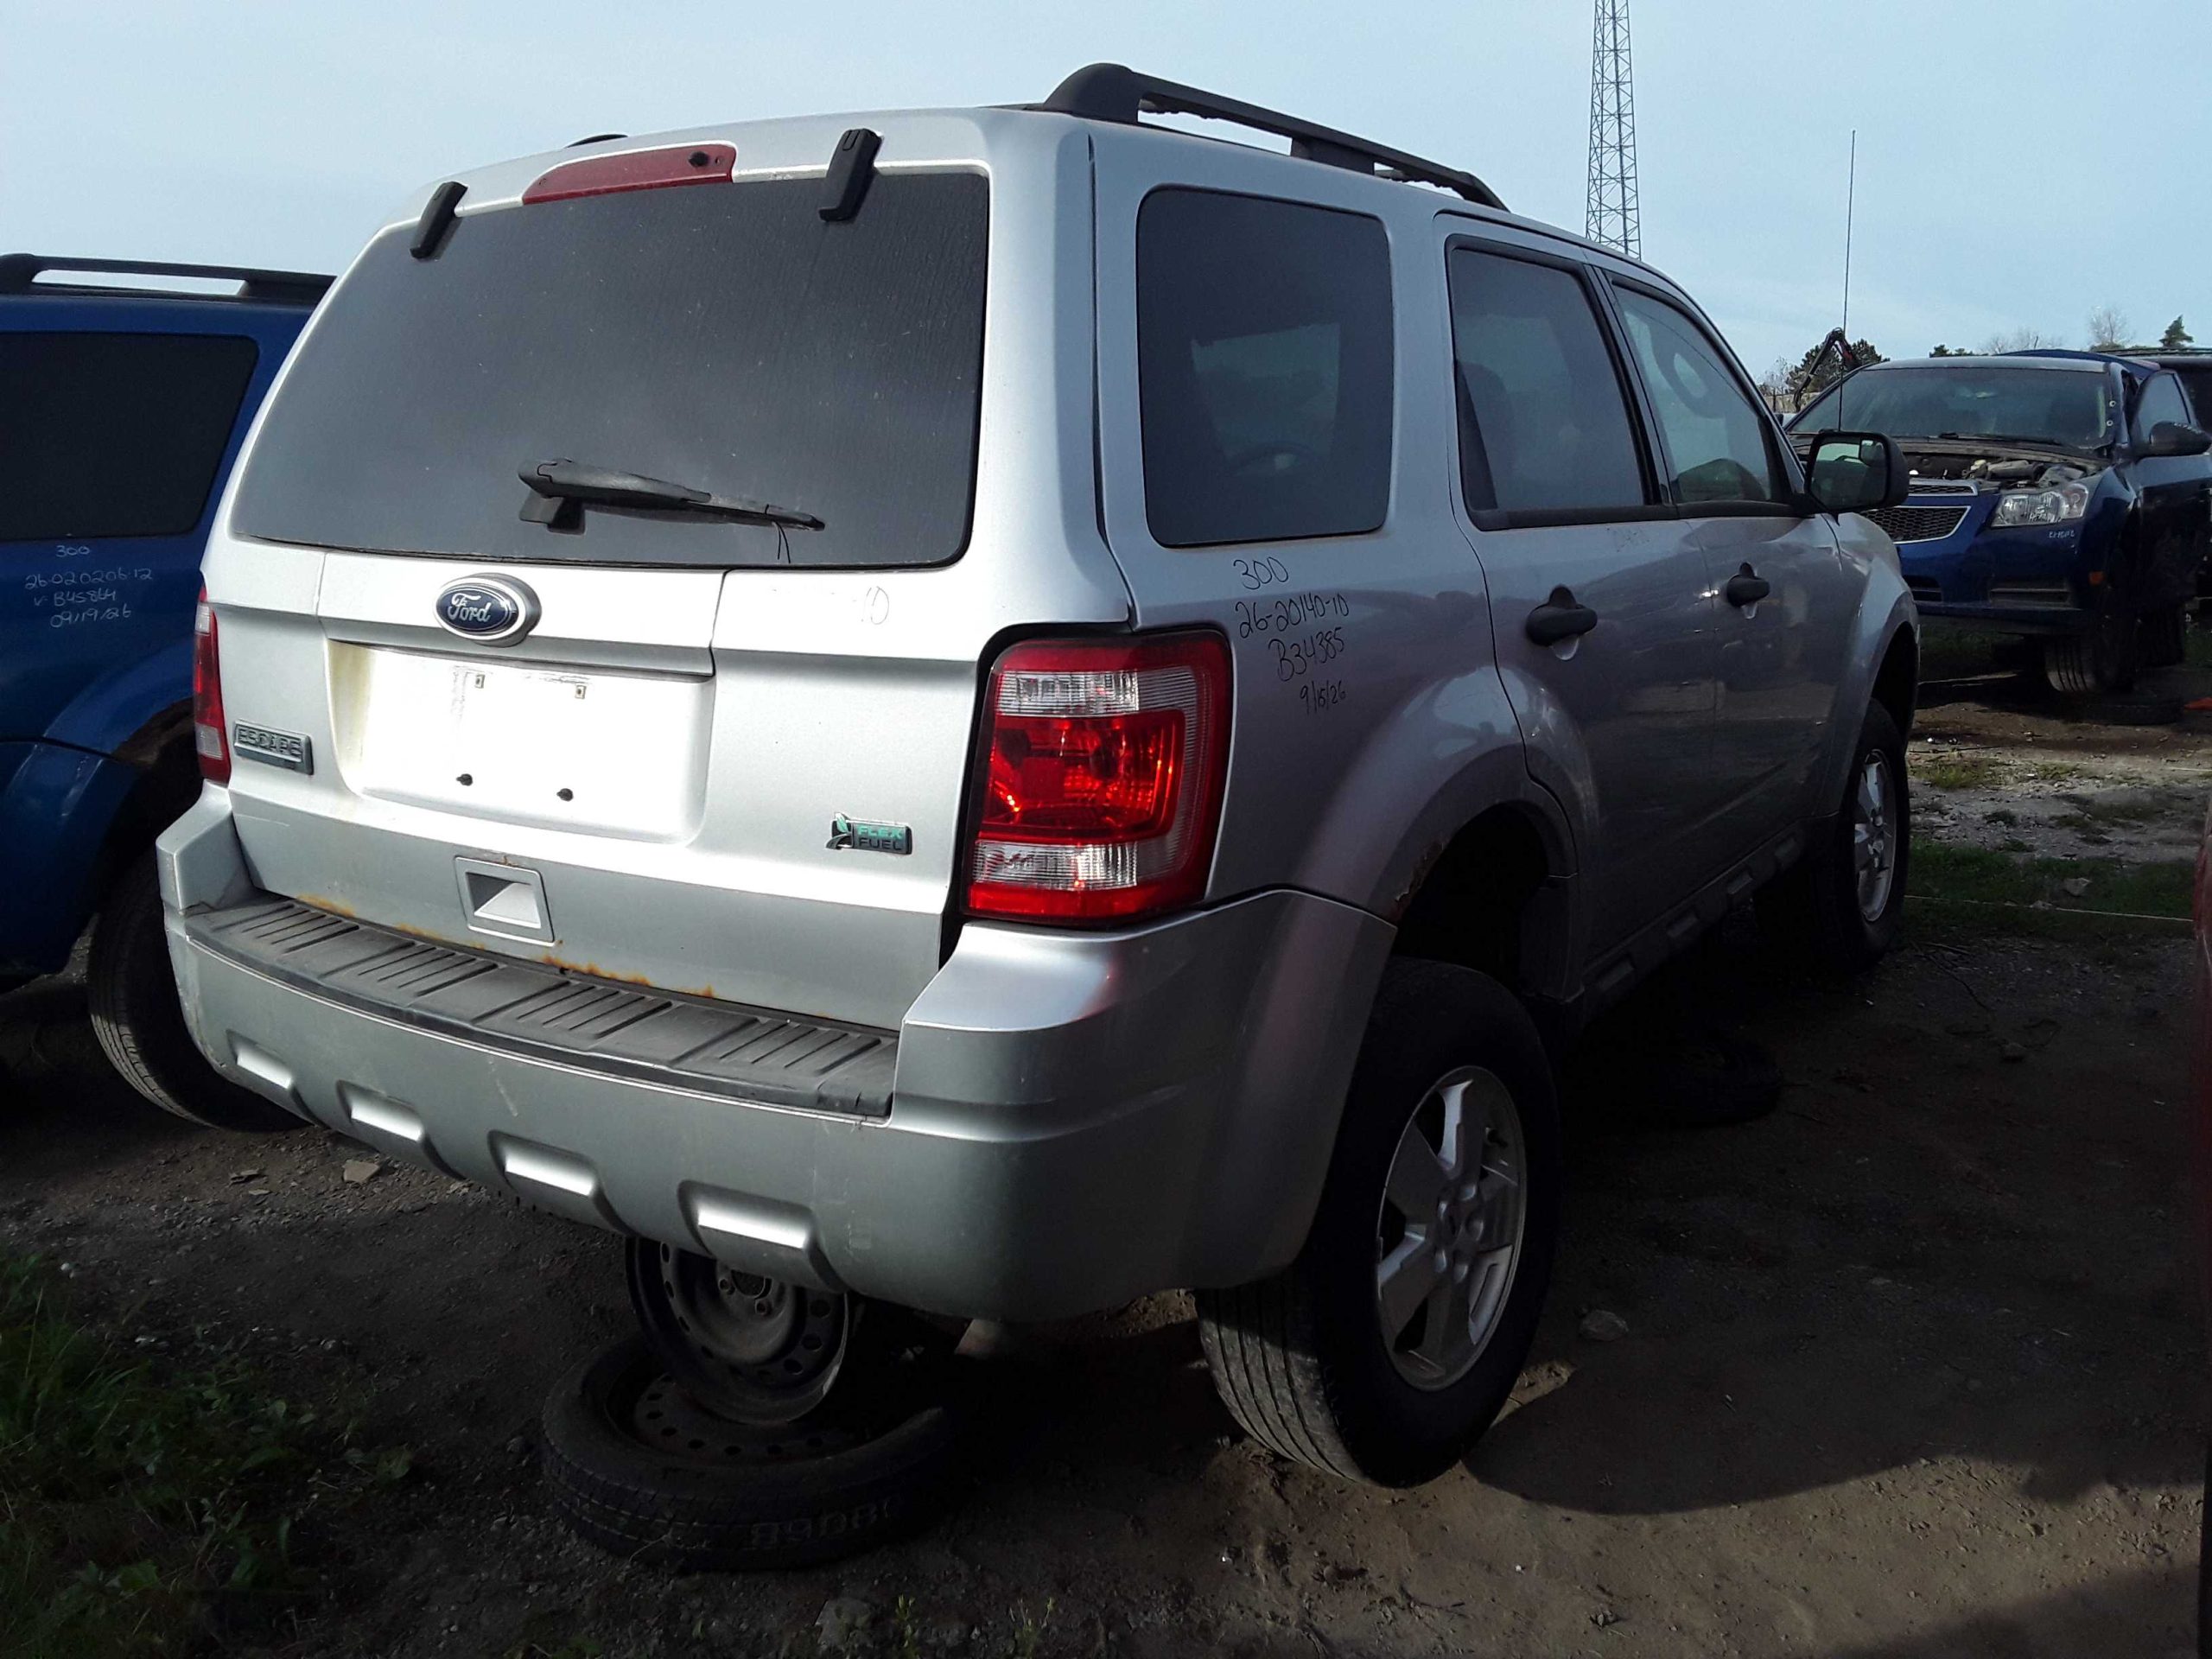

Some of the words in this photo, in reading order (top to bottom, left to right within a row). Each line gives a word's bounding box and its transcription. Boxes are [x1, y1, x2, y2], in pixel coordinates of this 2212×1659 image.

[55, 544, 91, 558] 300
[1232, 556, 1289, 590] 300
[446, 592, 493, 623] Ford
[1268, 626, 1345, 682] B34385
[237, 727, 303, 758] ESCAPE
[856, 824, 904, 839] FLEX
[857, 836, 903, 851] FUEL
